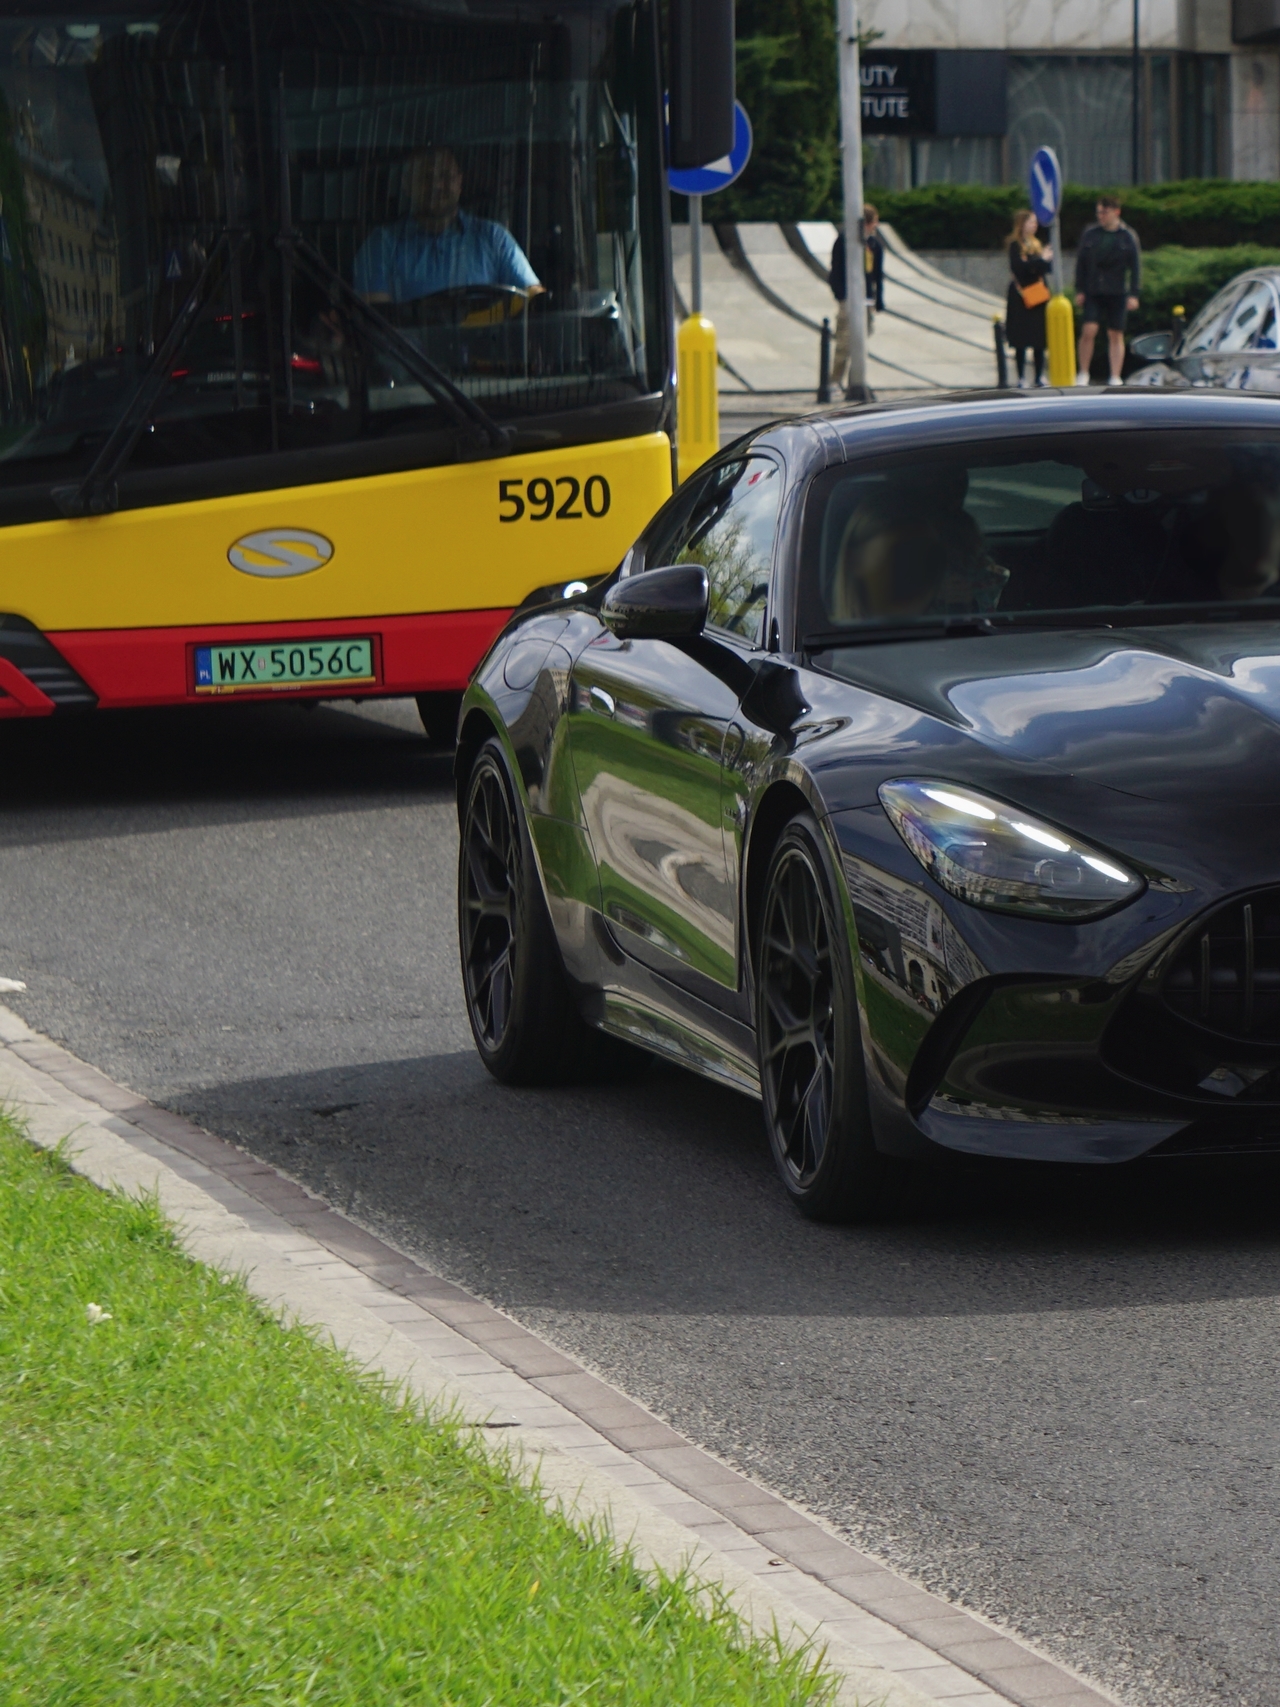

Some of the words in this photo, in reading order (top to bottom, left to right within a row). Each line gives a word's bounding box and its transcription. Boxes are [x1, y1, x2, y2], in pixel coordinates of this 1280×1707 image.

[860, 65, 898, 87] UTY
[861, 96, 909, 118] TUTE
[499, 475, 611, 523] 5920
[218, 651, 256, 681] WX
[271, 645, 363, 677] 5056C
